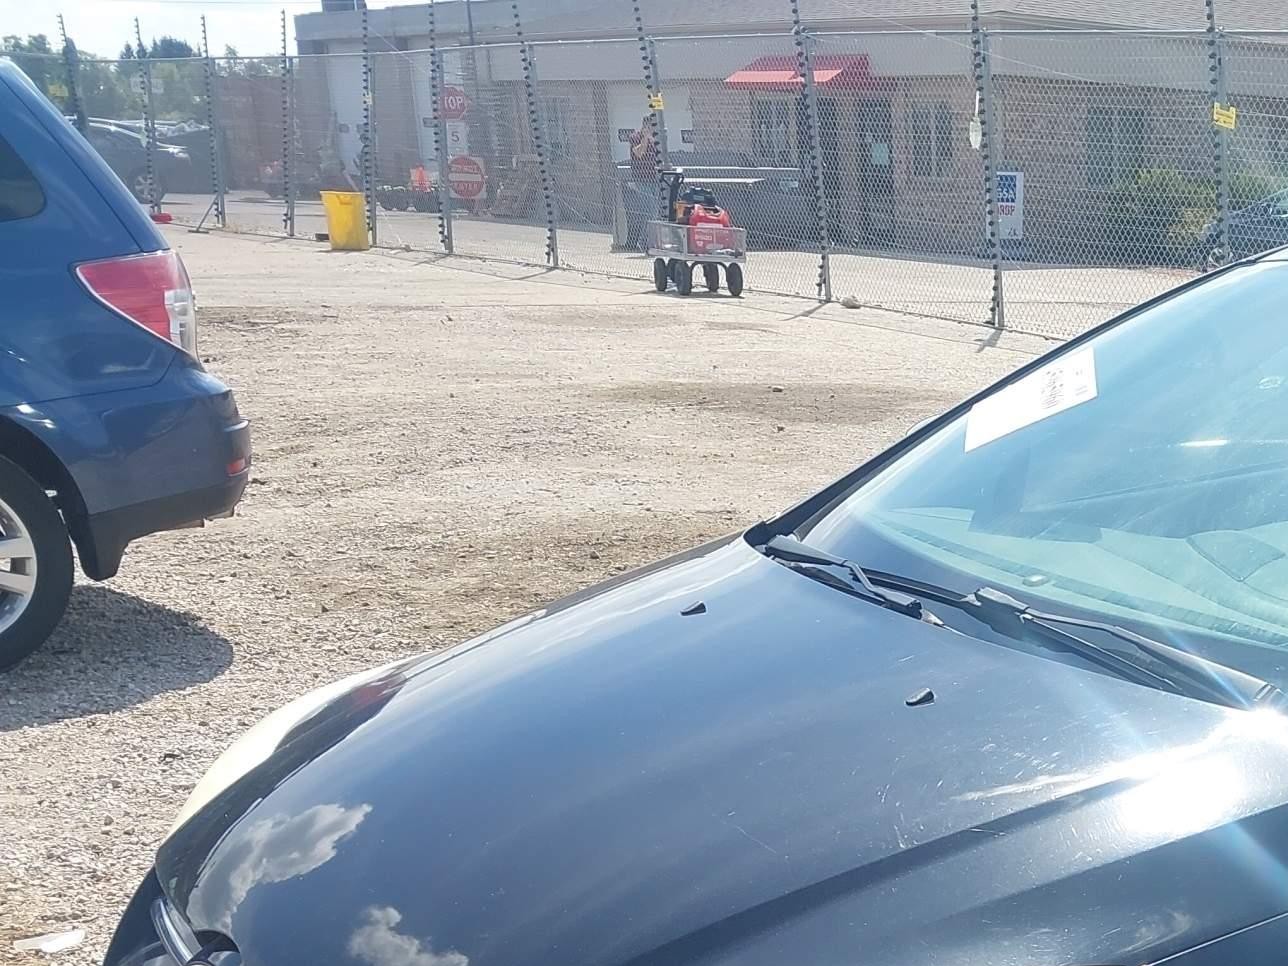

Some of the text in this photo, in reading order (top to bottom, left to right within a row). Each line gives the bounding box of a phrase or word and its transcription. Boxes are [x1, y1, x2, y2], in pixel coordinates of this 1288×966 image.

[444, 96, 464, 111] TOP
[451, 131, 460, 143] 5
[999, 204, 1016, 217] ROP
